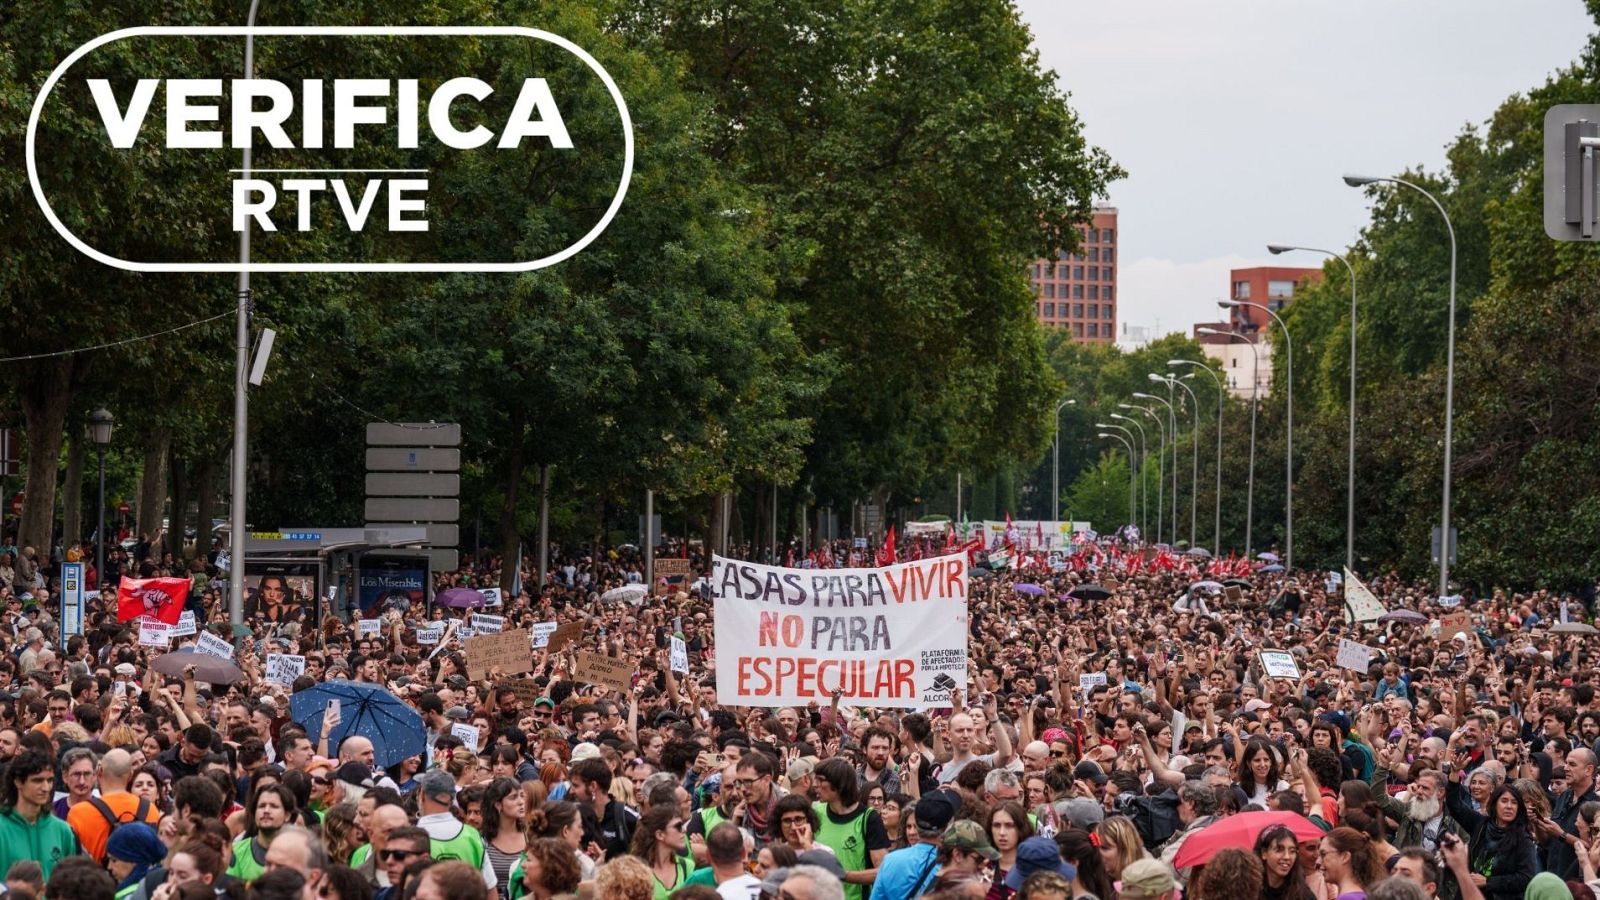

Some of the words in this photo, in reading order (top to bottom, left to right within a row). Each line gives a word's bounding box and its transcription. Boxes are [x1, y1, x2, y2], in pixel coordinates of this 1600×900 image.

[360, 577, 377, 587] Los
[811, 573, 887, 607] PARA
[884, 558, 965, 604] VIVIR
[759, 611, 804, 648] NO
[811, 615, 891, 651] PARA
[921, 649, 965, 658] PLATAFORMA
[930, 656, 965, 665] AFECTADOS
[939, 663, 965, 671] HIPOTECA
[737, 656, 916, 698] ESPECULAR
